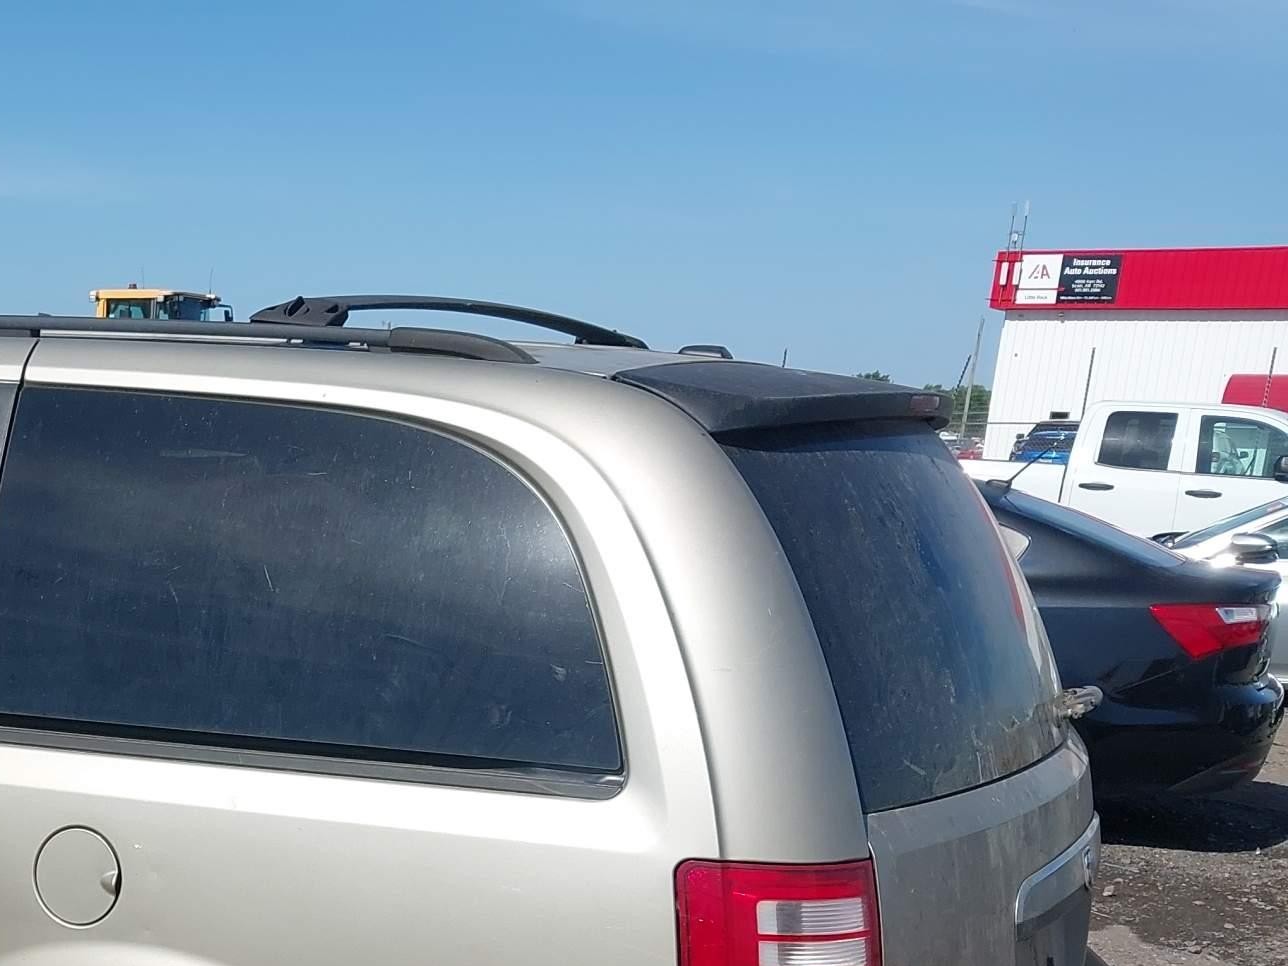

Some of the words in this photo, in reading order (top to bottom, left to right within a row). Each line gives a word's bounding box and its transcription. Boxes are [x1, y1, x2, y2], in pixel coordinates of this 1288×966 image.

[1073, 258, 1111, 266] Insurance
[1064, 266, 1082, 275] Auto
[1083, 266, 1117, 275] Auctions
